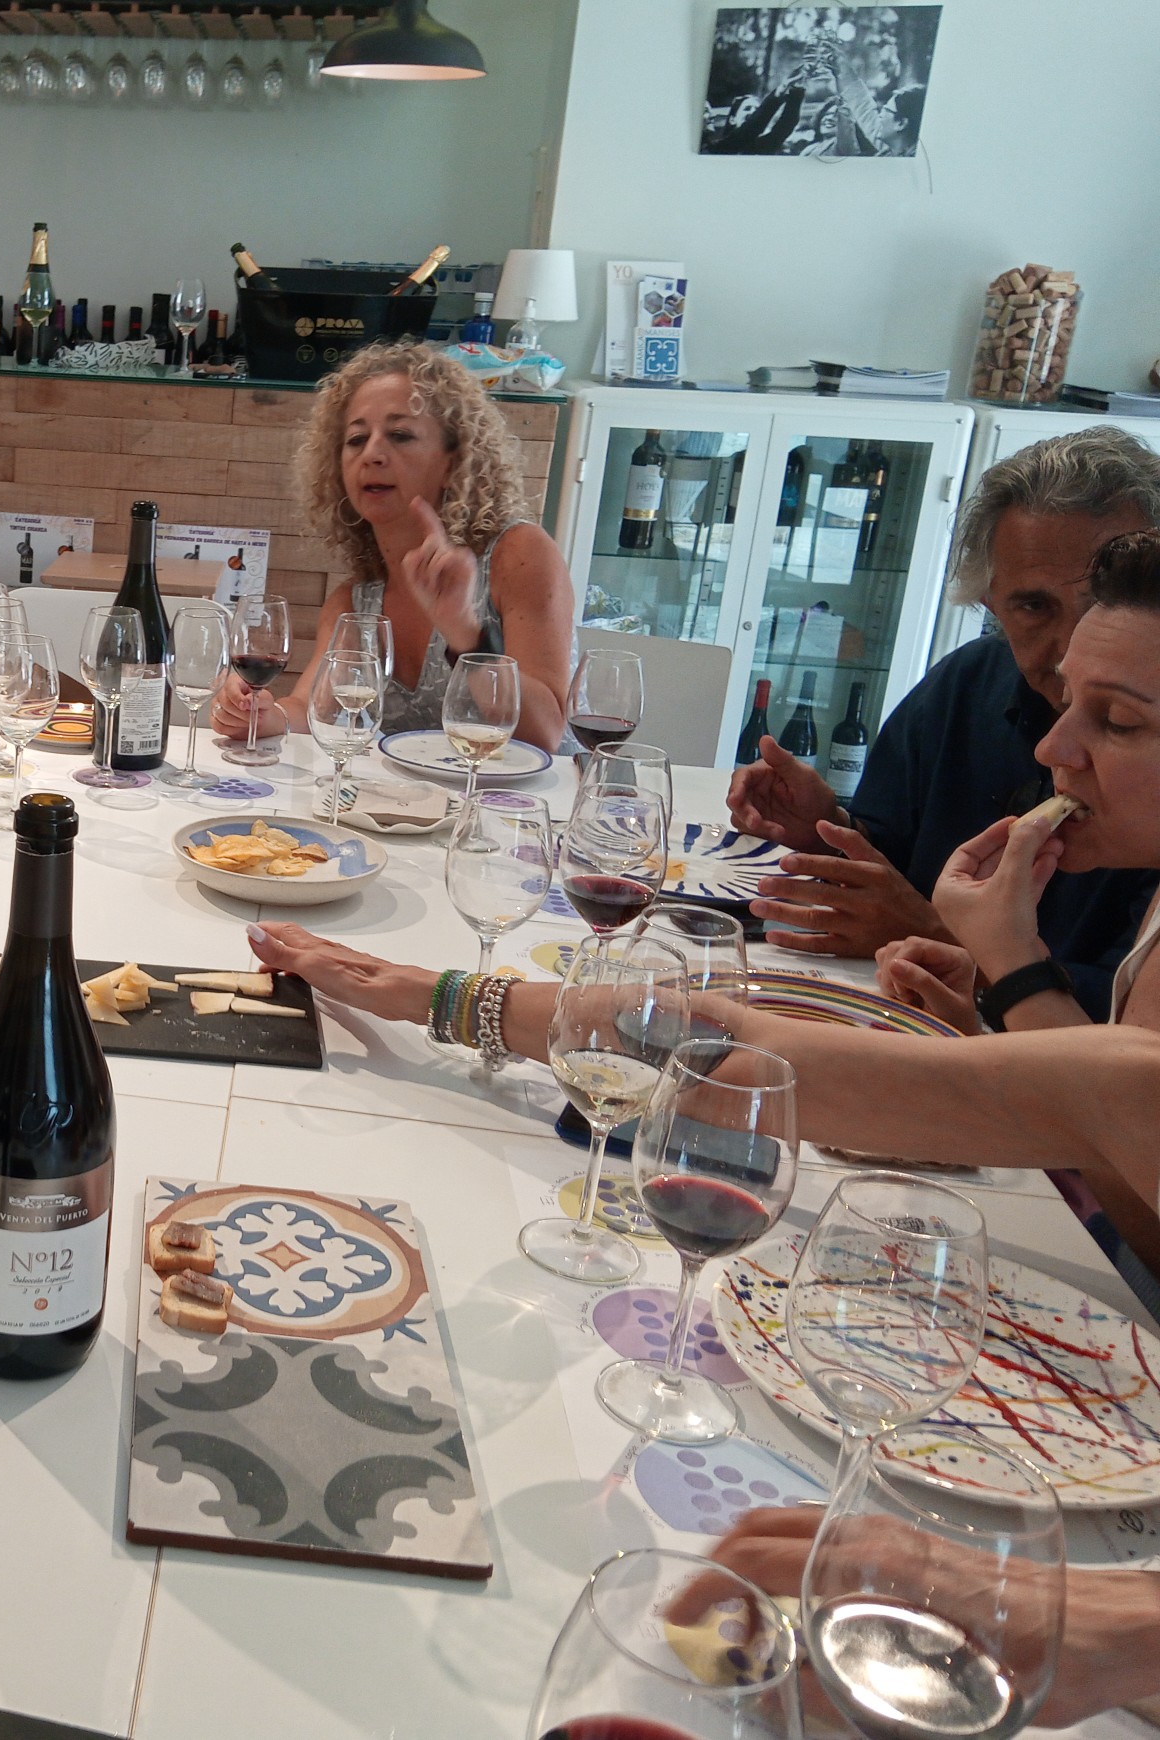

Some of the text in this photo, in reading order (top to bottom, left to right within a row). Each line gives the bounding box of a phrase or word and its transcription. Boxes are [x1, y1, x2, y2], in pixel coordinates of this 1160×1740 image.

[316, 317, 365, 329] PROAVA
[0, 1208, 89, 1225] VENTA DEL PUERTO
